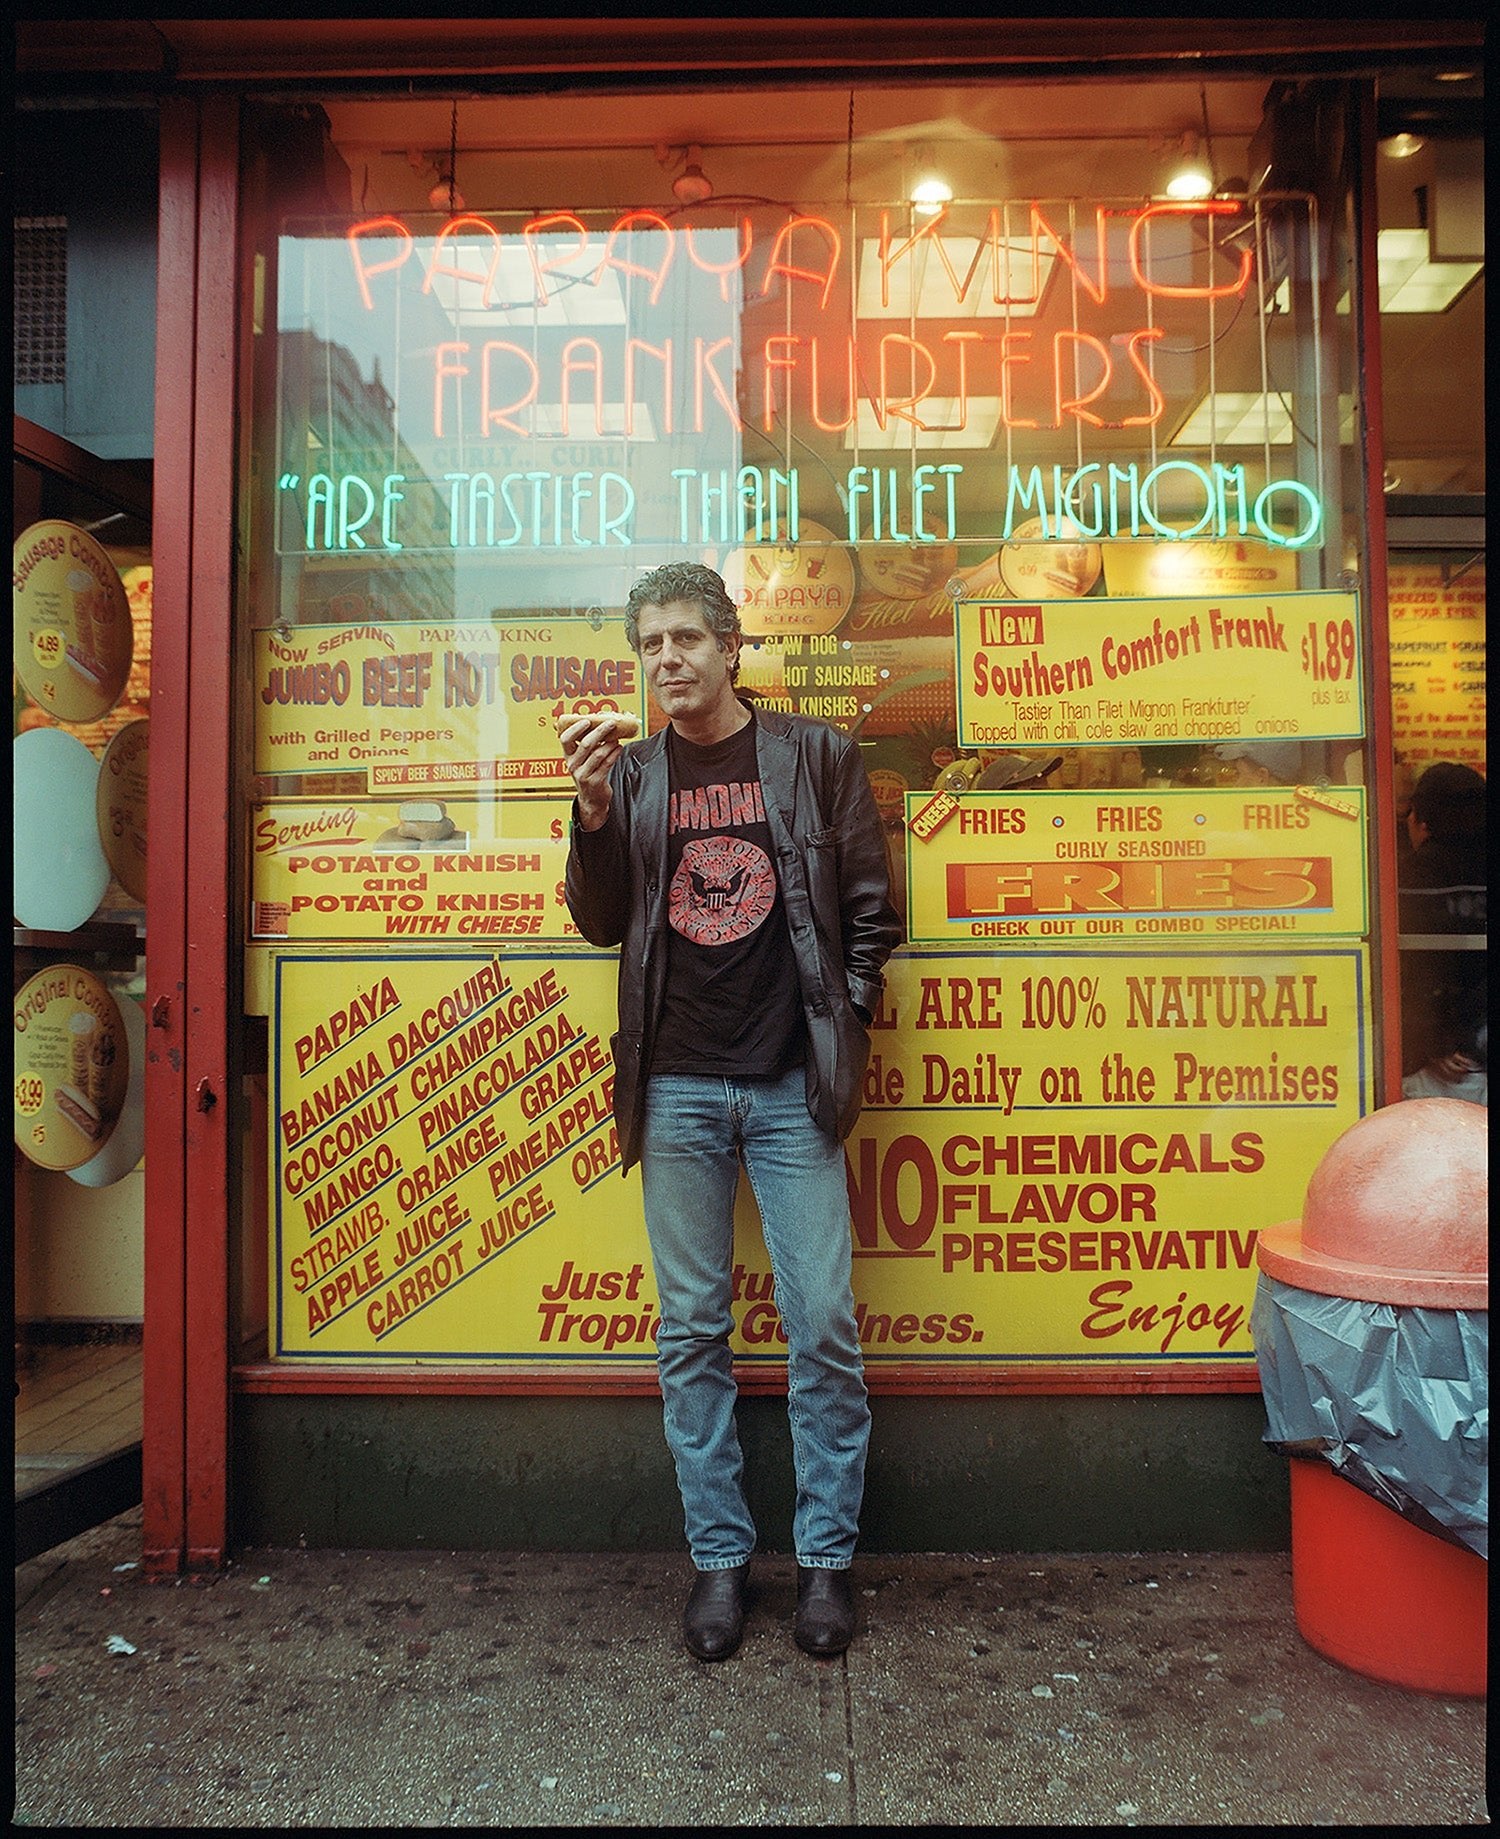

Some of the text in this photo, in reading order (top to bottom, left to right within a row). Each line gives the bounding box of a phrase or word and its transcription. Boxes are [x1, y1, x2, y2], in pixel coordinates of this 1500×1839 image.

[347, 210, 840, 310] PAPAYA
[444, 471, 635, 547] TASTIER
[672, 466, 798, 545] THAN
[848, 464, 963, 543] FILET
[734, 586, 842, 609] PAPAYA
[852, 600, 917, 632] Filet
[419, 628, 552, 643] PAPAYA KING
[763, 615, 814, 625] KING
[985, 607, 1038, 646] New
[268, 626, 395, 663] NOW SERVING
[765, 635, 803, 655] SLAW
[810, 635, 838, 655] DOG
[973, 606, 1288, 699] Southern Comfort Frank
[1301, 618, 1355, 683] $1.89
[262, 650, 637, 708] JUMBO BEEF HOT SAUSAGE
[782, 665, 809, 687] HOT
[815, 665, 877, 687] SAUSAGE
[799, 697, 858, 717] KNISHES
[1059, 700, 1091, 719] Than
[1097, 700, 1124, 719] Filet
[1130, 699, 1176, 721] Mignon
[1311, 688, 1351, 708] plus tax
[270, 728, 454, 746] with Grilled Peppers
[970, 717, 1299, 744] Topped with chili, cole slaw and chopped onions
[308, 747, 338, 762] and
[375, 766, 402, 783] SPICY
[408, 766, 429, 782] BEEF
[433, 764, 476, 780] SAUSAGE
[497, 761, 525, 777] BEEFY
[529, 760, 558, 776] ZESTY
[911, 791, 959, 839] CHEESE
[960, 803, 1311, 835] FRIES FRIES FRIES
[1298, 785, 1360, 819] CHEESE
[256, 806, 359, 852] Serving
[288, 855, 541, 874] POTATO KNISH
[1055, 839, 1206, 859] CURLY SEASONED
[363, 873, 428, 892] and
[963, 861, 1318, 914] FRIES
[292, 894, 424, 913] POTATO
[437, 893, 544, 911] KNISH
[385, 915, 544, 935] WITH CHEESE
[971, 916, 1297, 937] CHECK OUT OUR COMBO SPECIAL!
[15, 974, 70, 1033] Original
[916, 977, 1002, 1030] ARE
[1021, 976, 1107, 1029] 100%
[1126, 975, 1328, 1029] NATURAL
[294, 976, 401, 1074] PAPAYA
[280, 959, 511, 1147] BANANA DACQUIRI.
[284, 968, 568, 1196] COCONUT CHAMPAGNE.
[922, 1054, 1022, 1116] Daily
[1040, 1068, 1082, 1103] on
[1100, 1054, 1156, 1103] the
[1174, 1052, 1339, 1102] Premises
[303, 1012, 584, 1232] MANGO. PINACOLADA.
[290, 1035, 612, 1293] STRAWB. ORANGE. GRAPE.
[942, 1132, 1265, 1175] CHEMICALS
[843, 1134, 939, 1250] NO
[943, 1183, 1157, 1223] FLAVOR
[307, 1249, 384, 1331] APPLE
[393, 1192, 470, 1268] JUICE.
[366, 1239, 466, 1336] CARROT
[477, 1183, 554, 1259] JUICE.
[943, 1229, 1261, 1273] PRESERVATIV
[543, 1261, 645, 1301] Just
